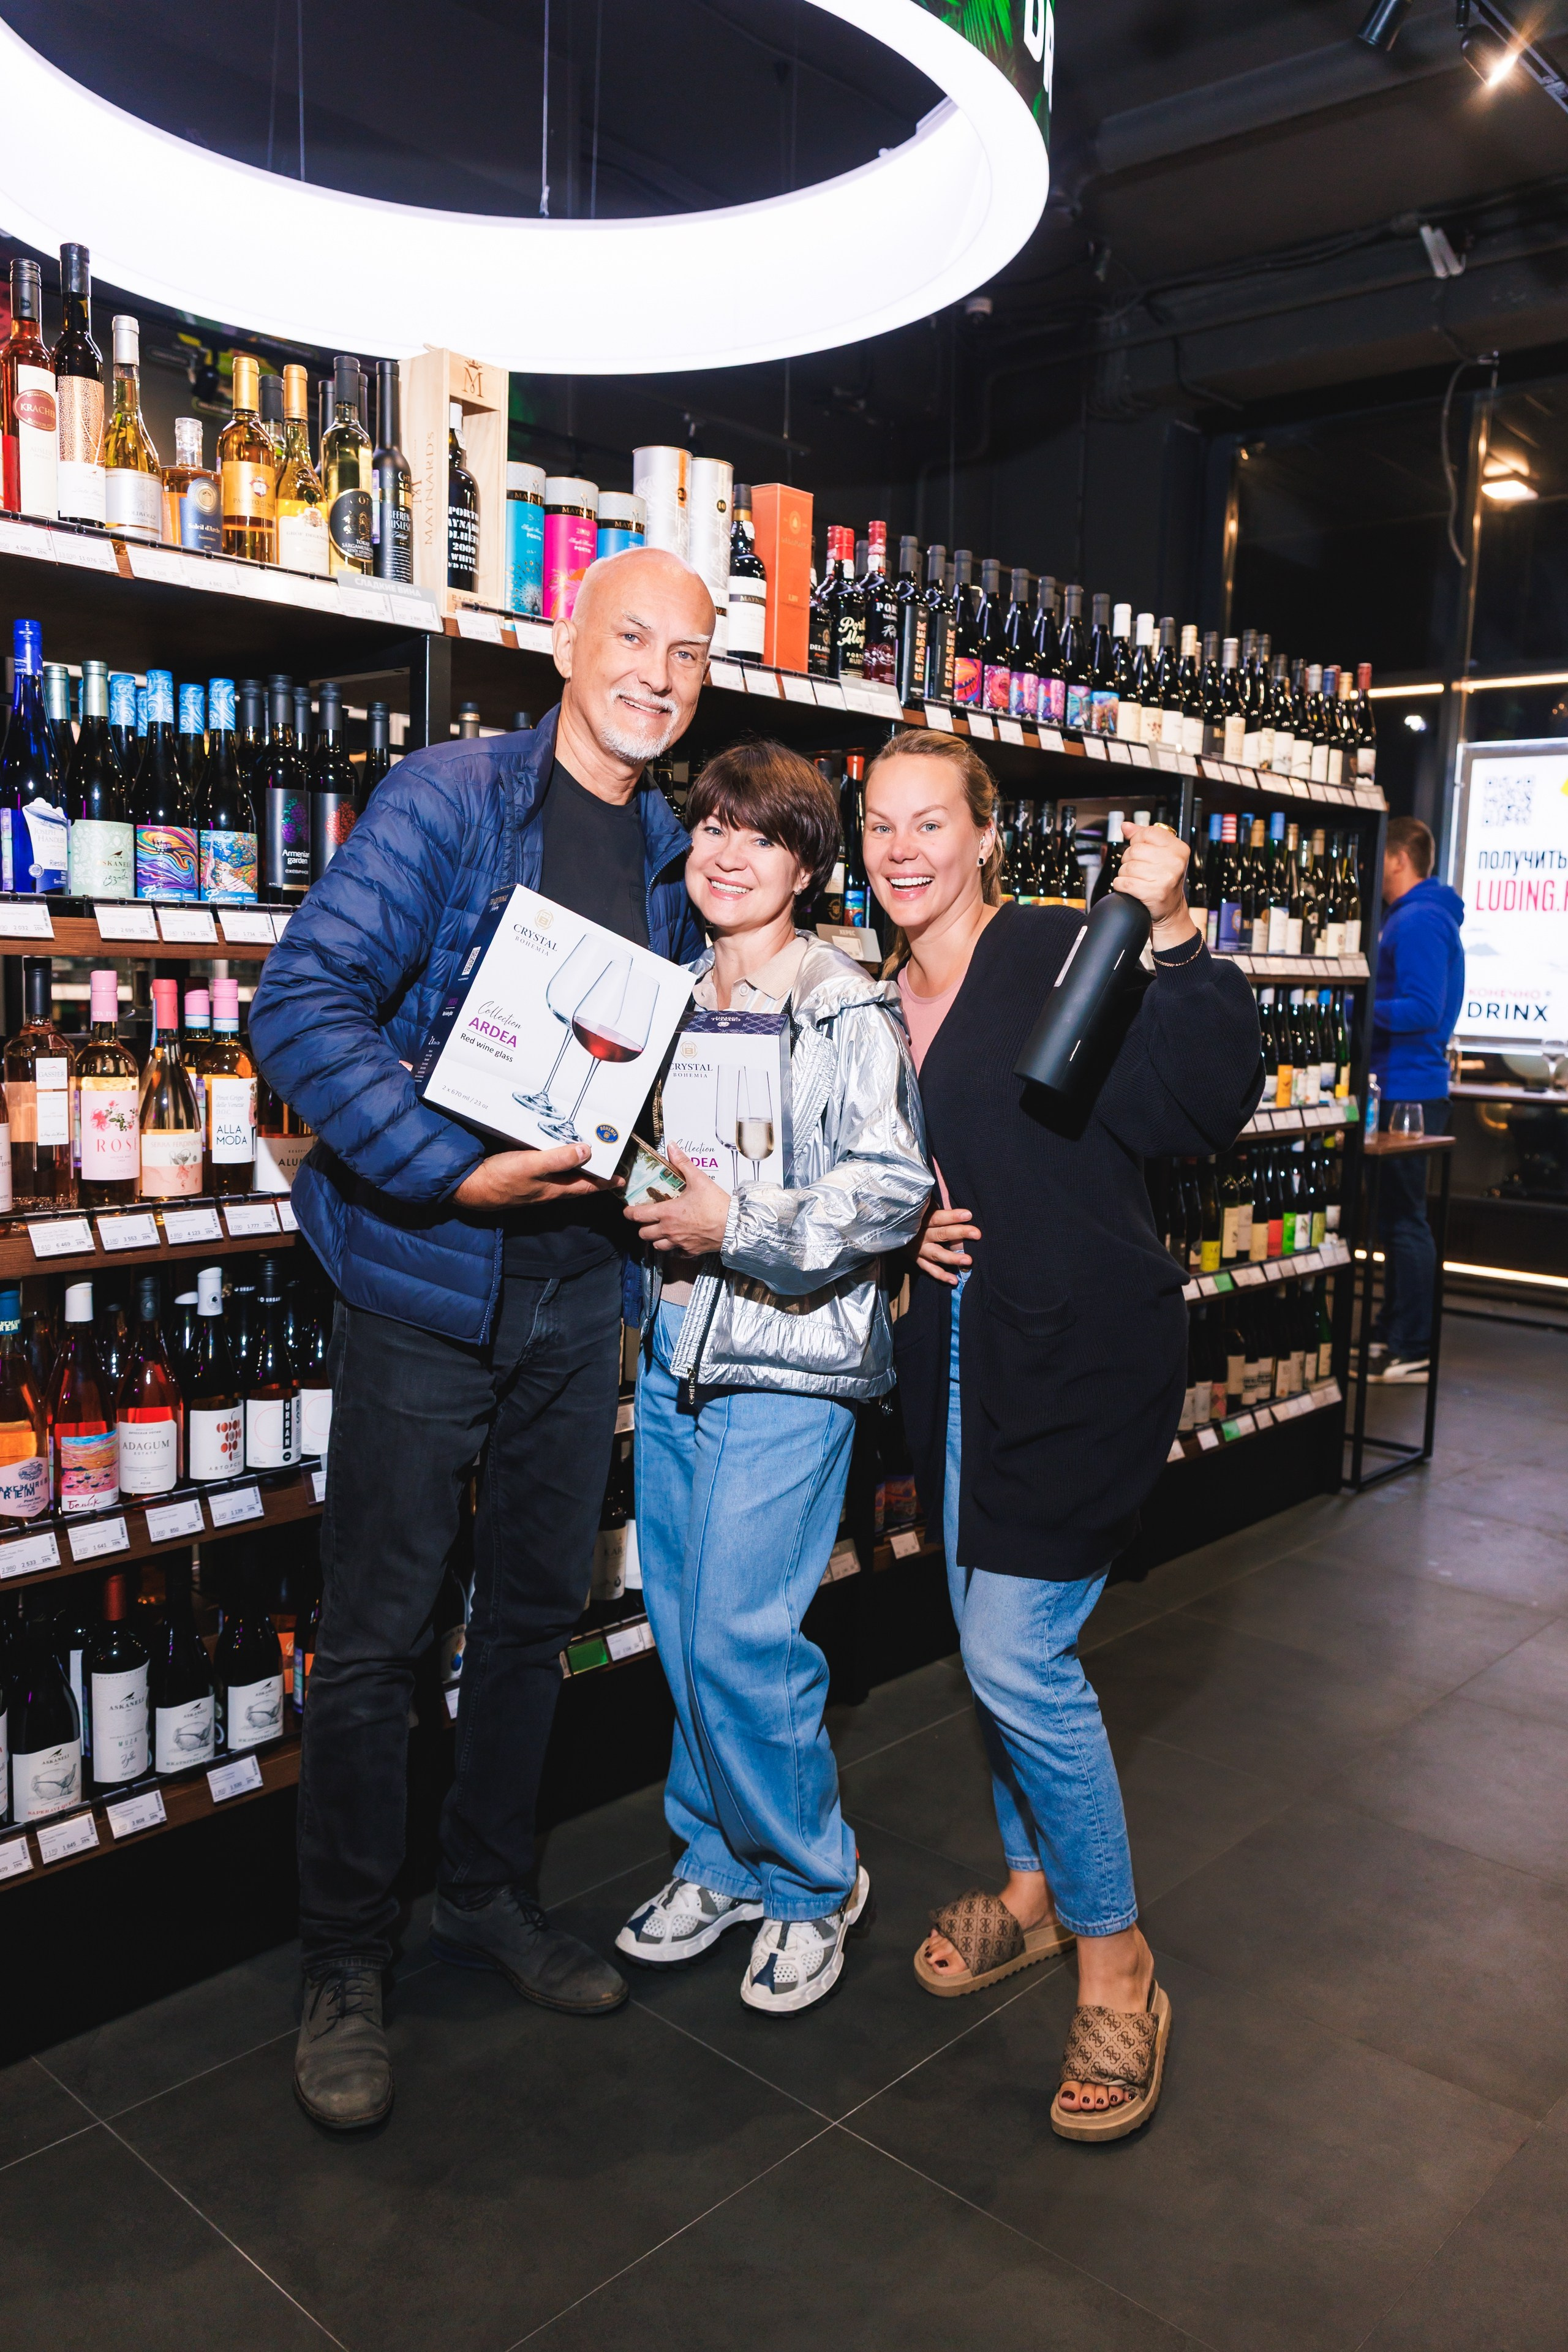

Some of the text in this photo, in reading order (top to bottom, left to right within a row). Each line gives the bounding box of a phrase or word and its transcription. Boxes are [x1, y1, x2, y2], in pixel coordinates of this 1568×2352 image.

[20, 403, 56, 418] KRACHE
[355, 577, 422, 598] СЛАДКИЕ ВИНА
[1478, 850, 1567, 876] получить
[513, 924, 558, 952] CRYSTAL
[515, 936, 549, 956] BOHEMIA
[478, 1001, 522, 1030] Collection
[1468, 1002, 1548, 1022] DRINX
[468, 1017, 517, 1048] ARDEA
[461, 1033, 513, 1063] Red wine glass
[668, 1063, 713, 1071] CRYSTAL
[216, 1124, 242, 1134] ALLA
[216, 1135, 247, 1145] MODA
[691, 1157, 718, 1167] DEA
